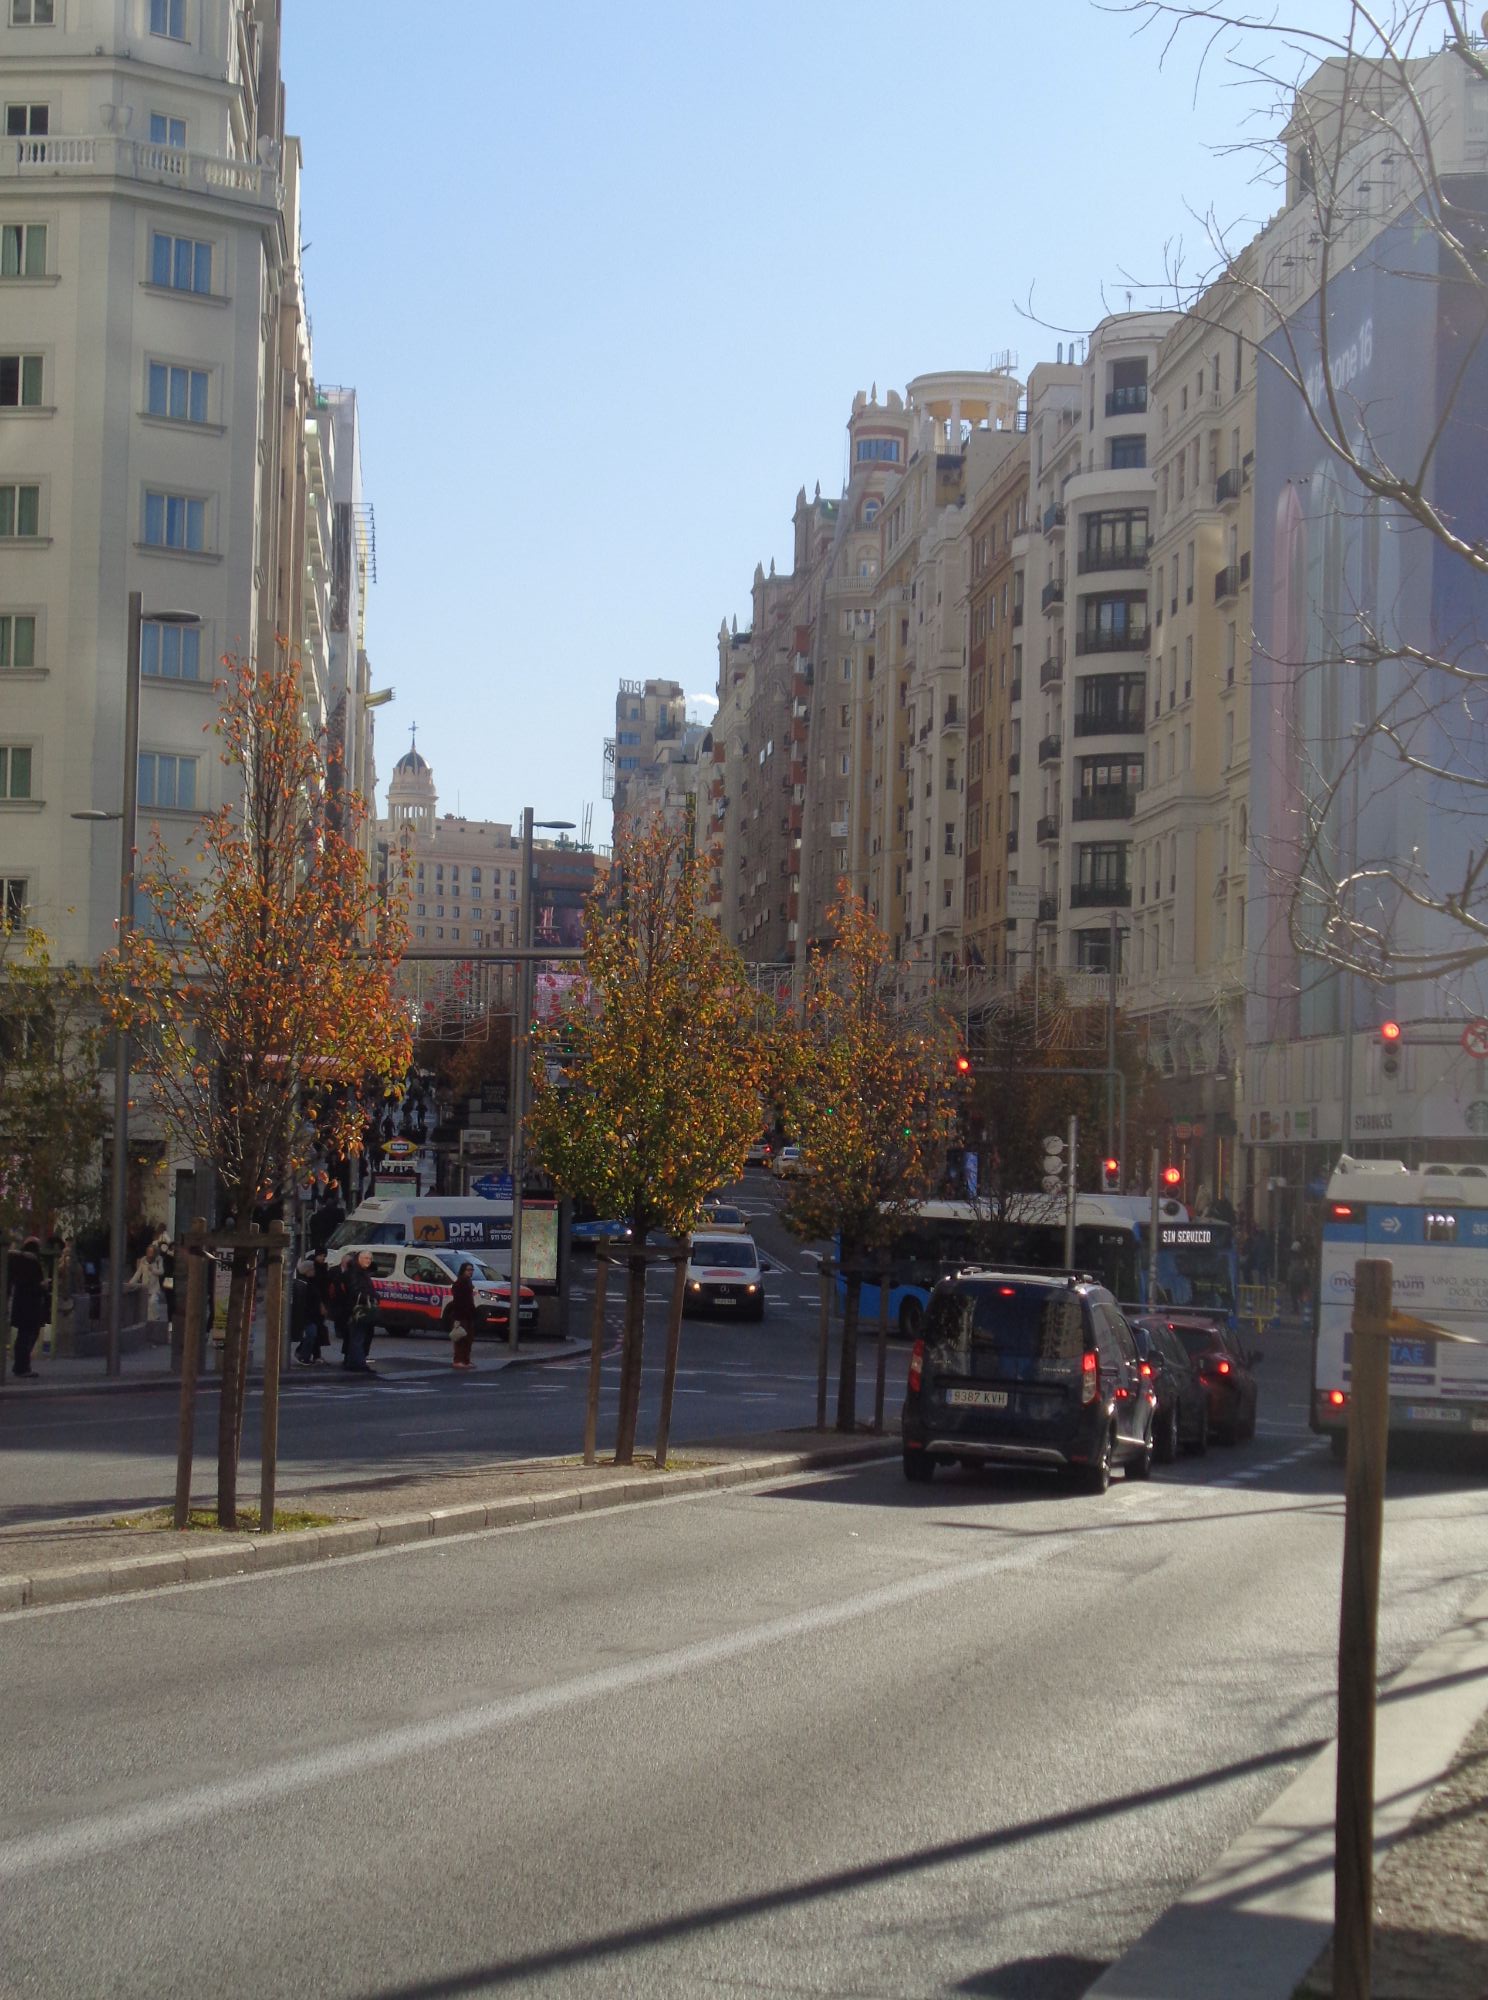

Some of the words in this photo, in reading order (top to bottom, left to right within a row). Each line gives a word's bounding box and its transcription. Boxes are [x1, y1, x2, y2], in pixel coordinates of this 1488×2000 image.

[1359, 318, 1373, 370] 16
[1354, 1112, 1393, 1131] STARBUCKS
[449, 1222, 484, 1237] DFM
[1162, 1230, 1176, 1243] SIN
[1177, 1230, 1211, 1243] SERVICIO
[954, 1391, 980, 1402] 9387
